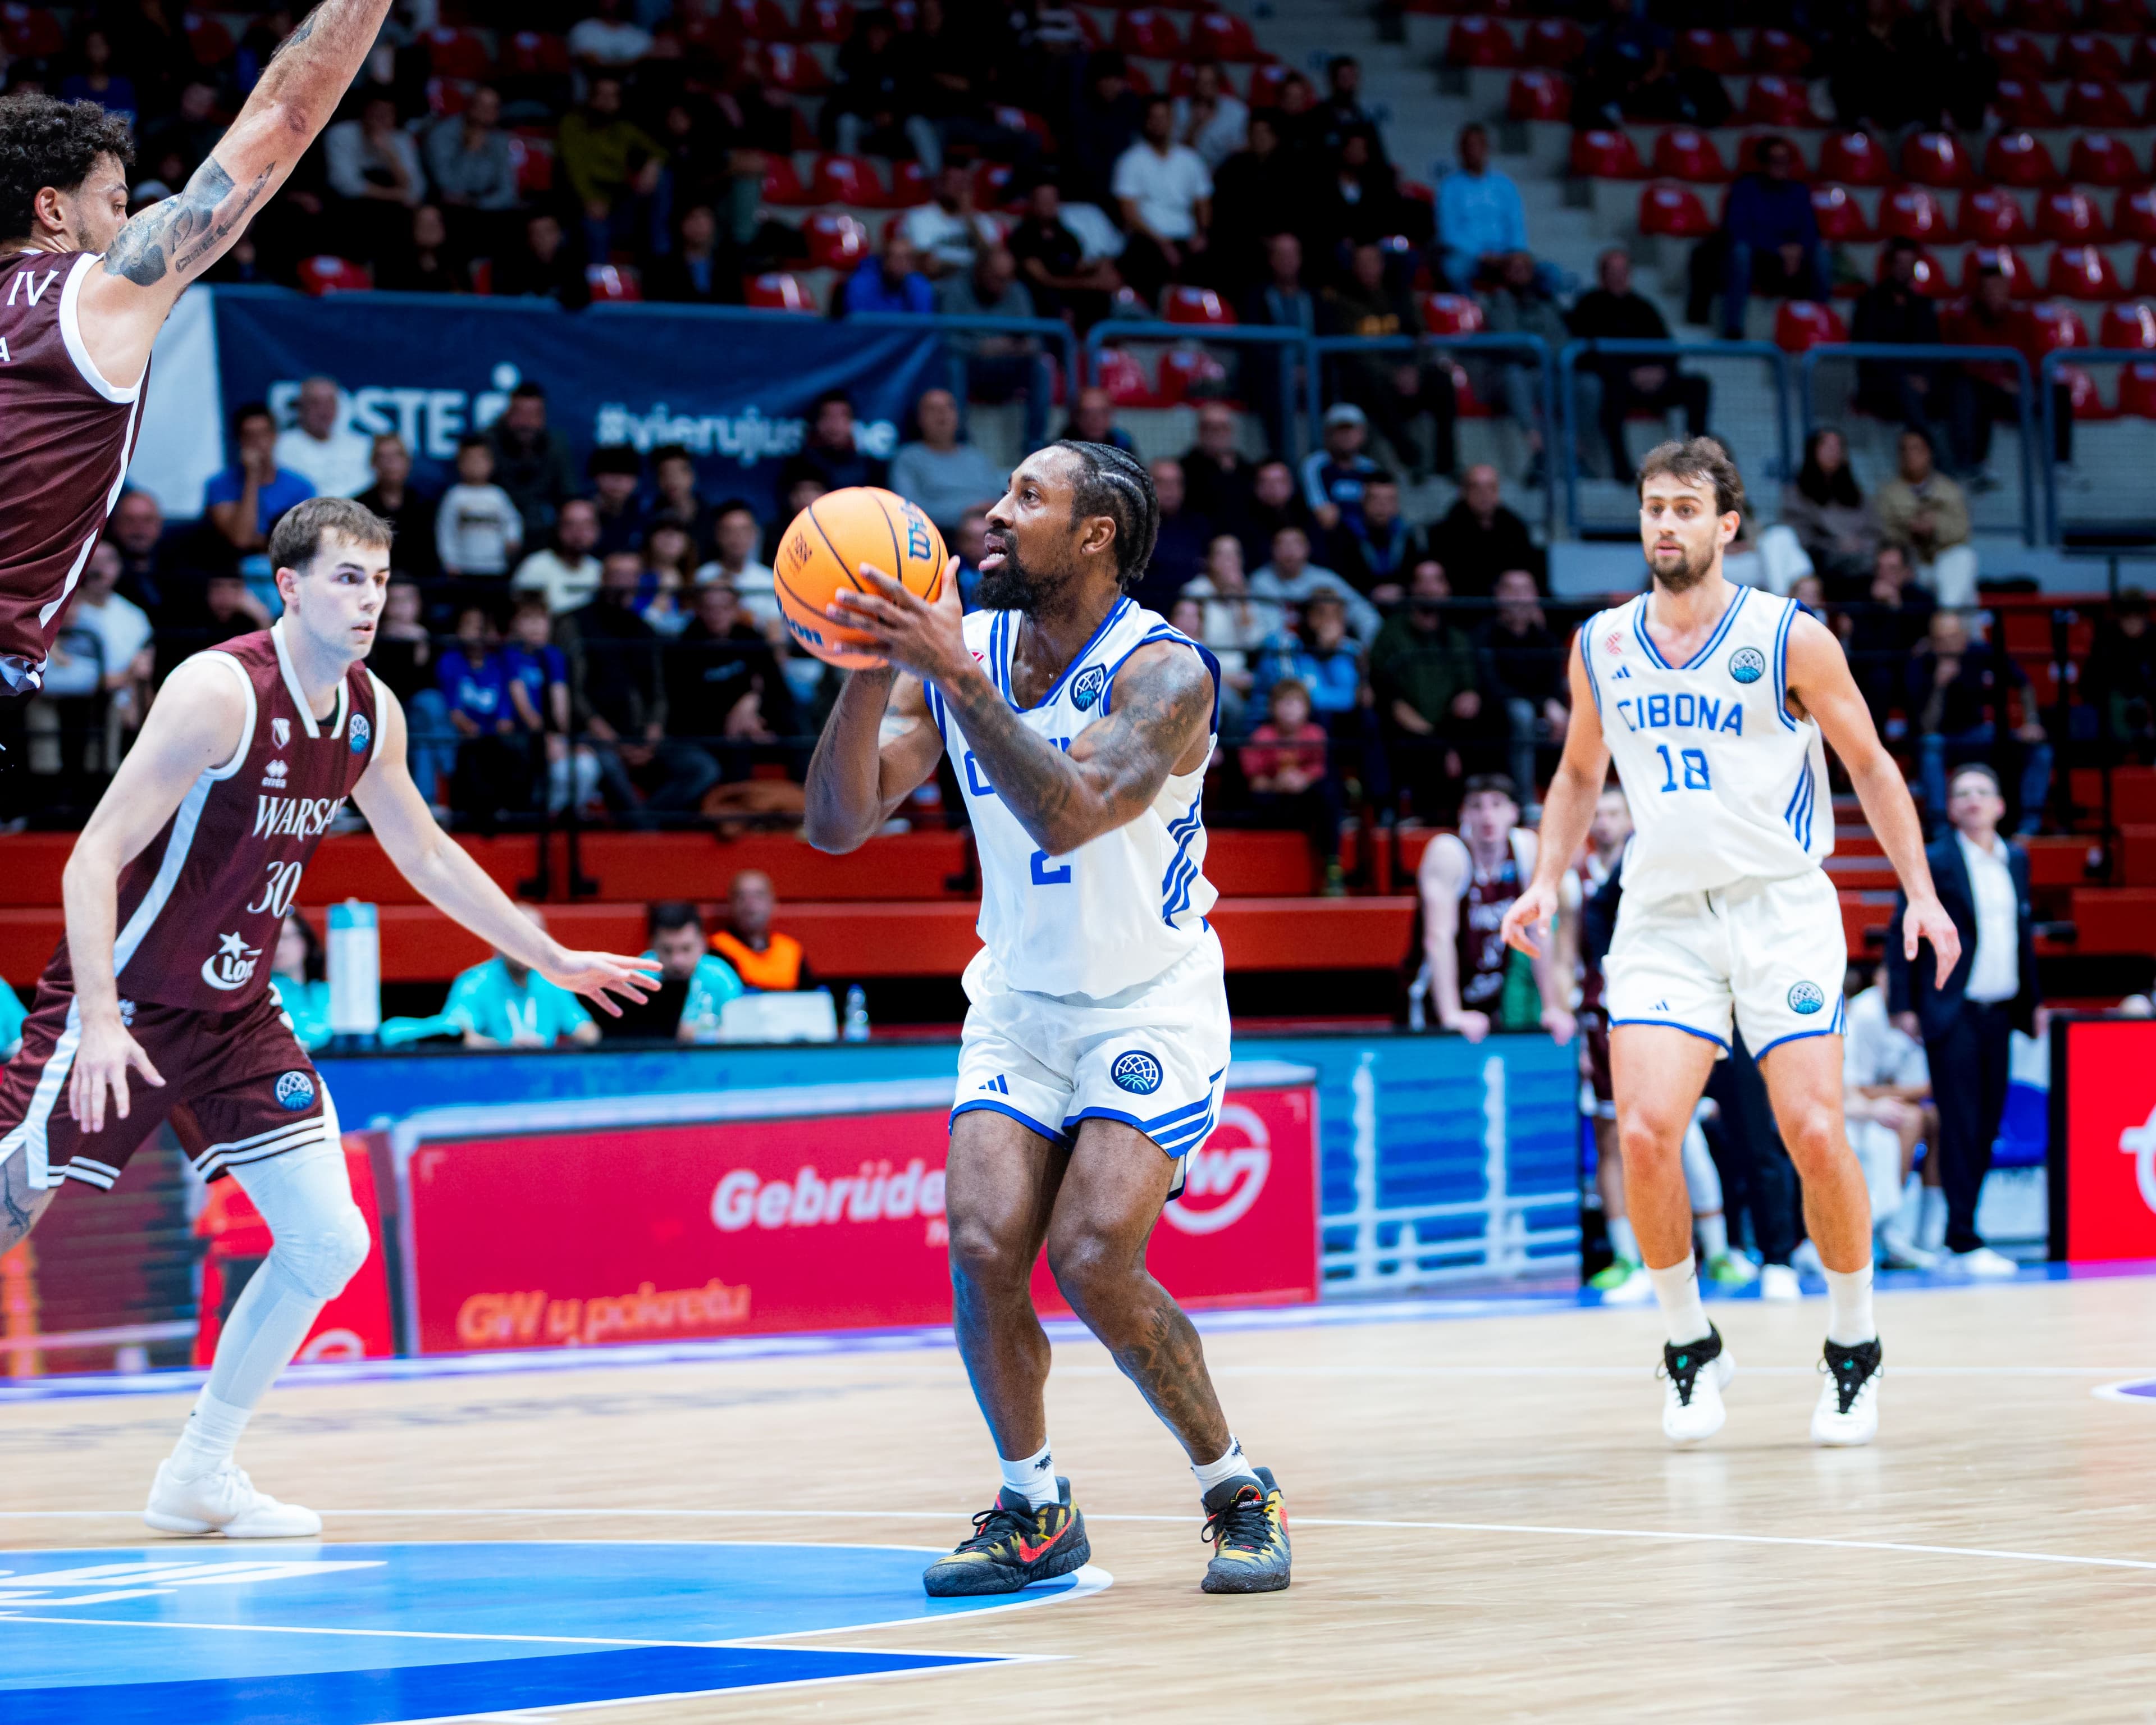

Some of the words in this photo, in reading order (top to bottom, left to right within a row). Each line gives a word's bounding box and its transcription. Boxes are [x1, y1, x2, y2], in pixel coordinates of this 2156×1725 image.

[7, 269, 60, 306] IV
[268, 380, 468, 459] ESTE
[1616, 693, 1743, 737] CIBONA
[1656, 744, 1712, 792] 18
[252, 795, 349, 842] WARSA
[246, 860, 303, 919] 30
[711, 1158, 949, 1233] Gebrüde
